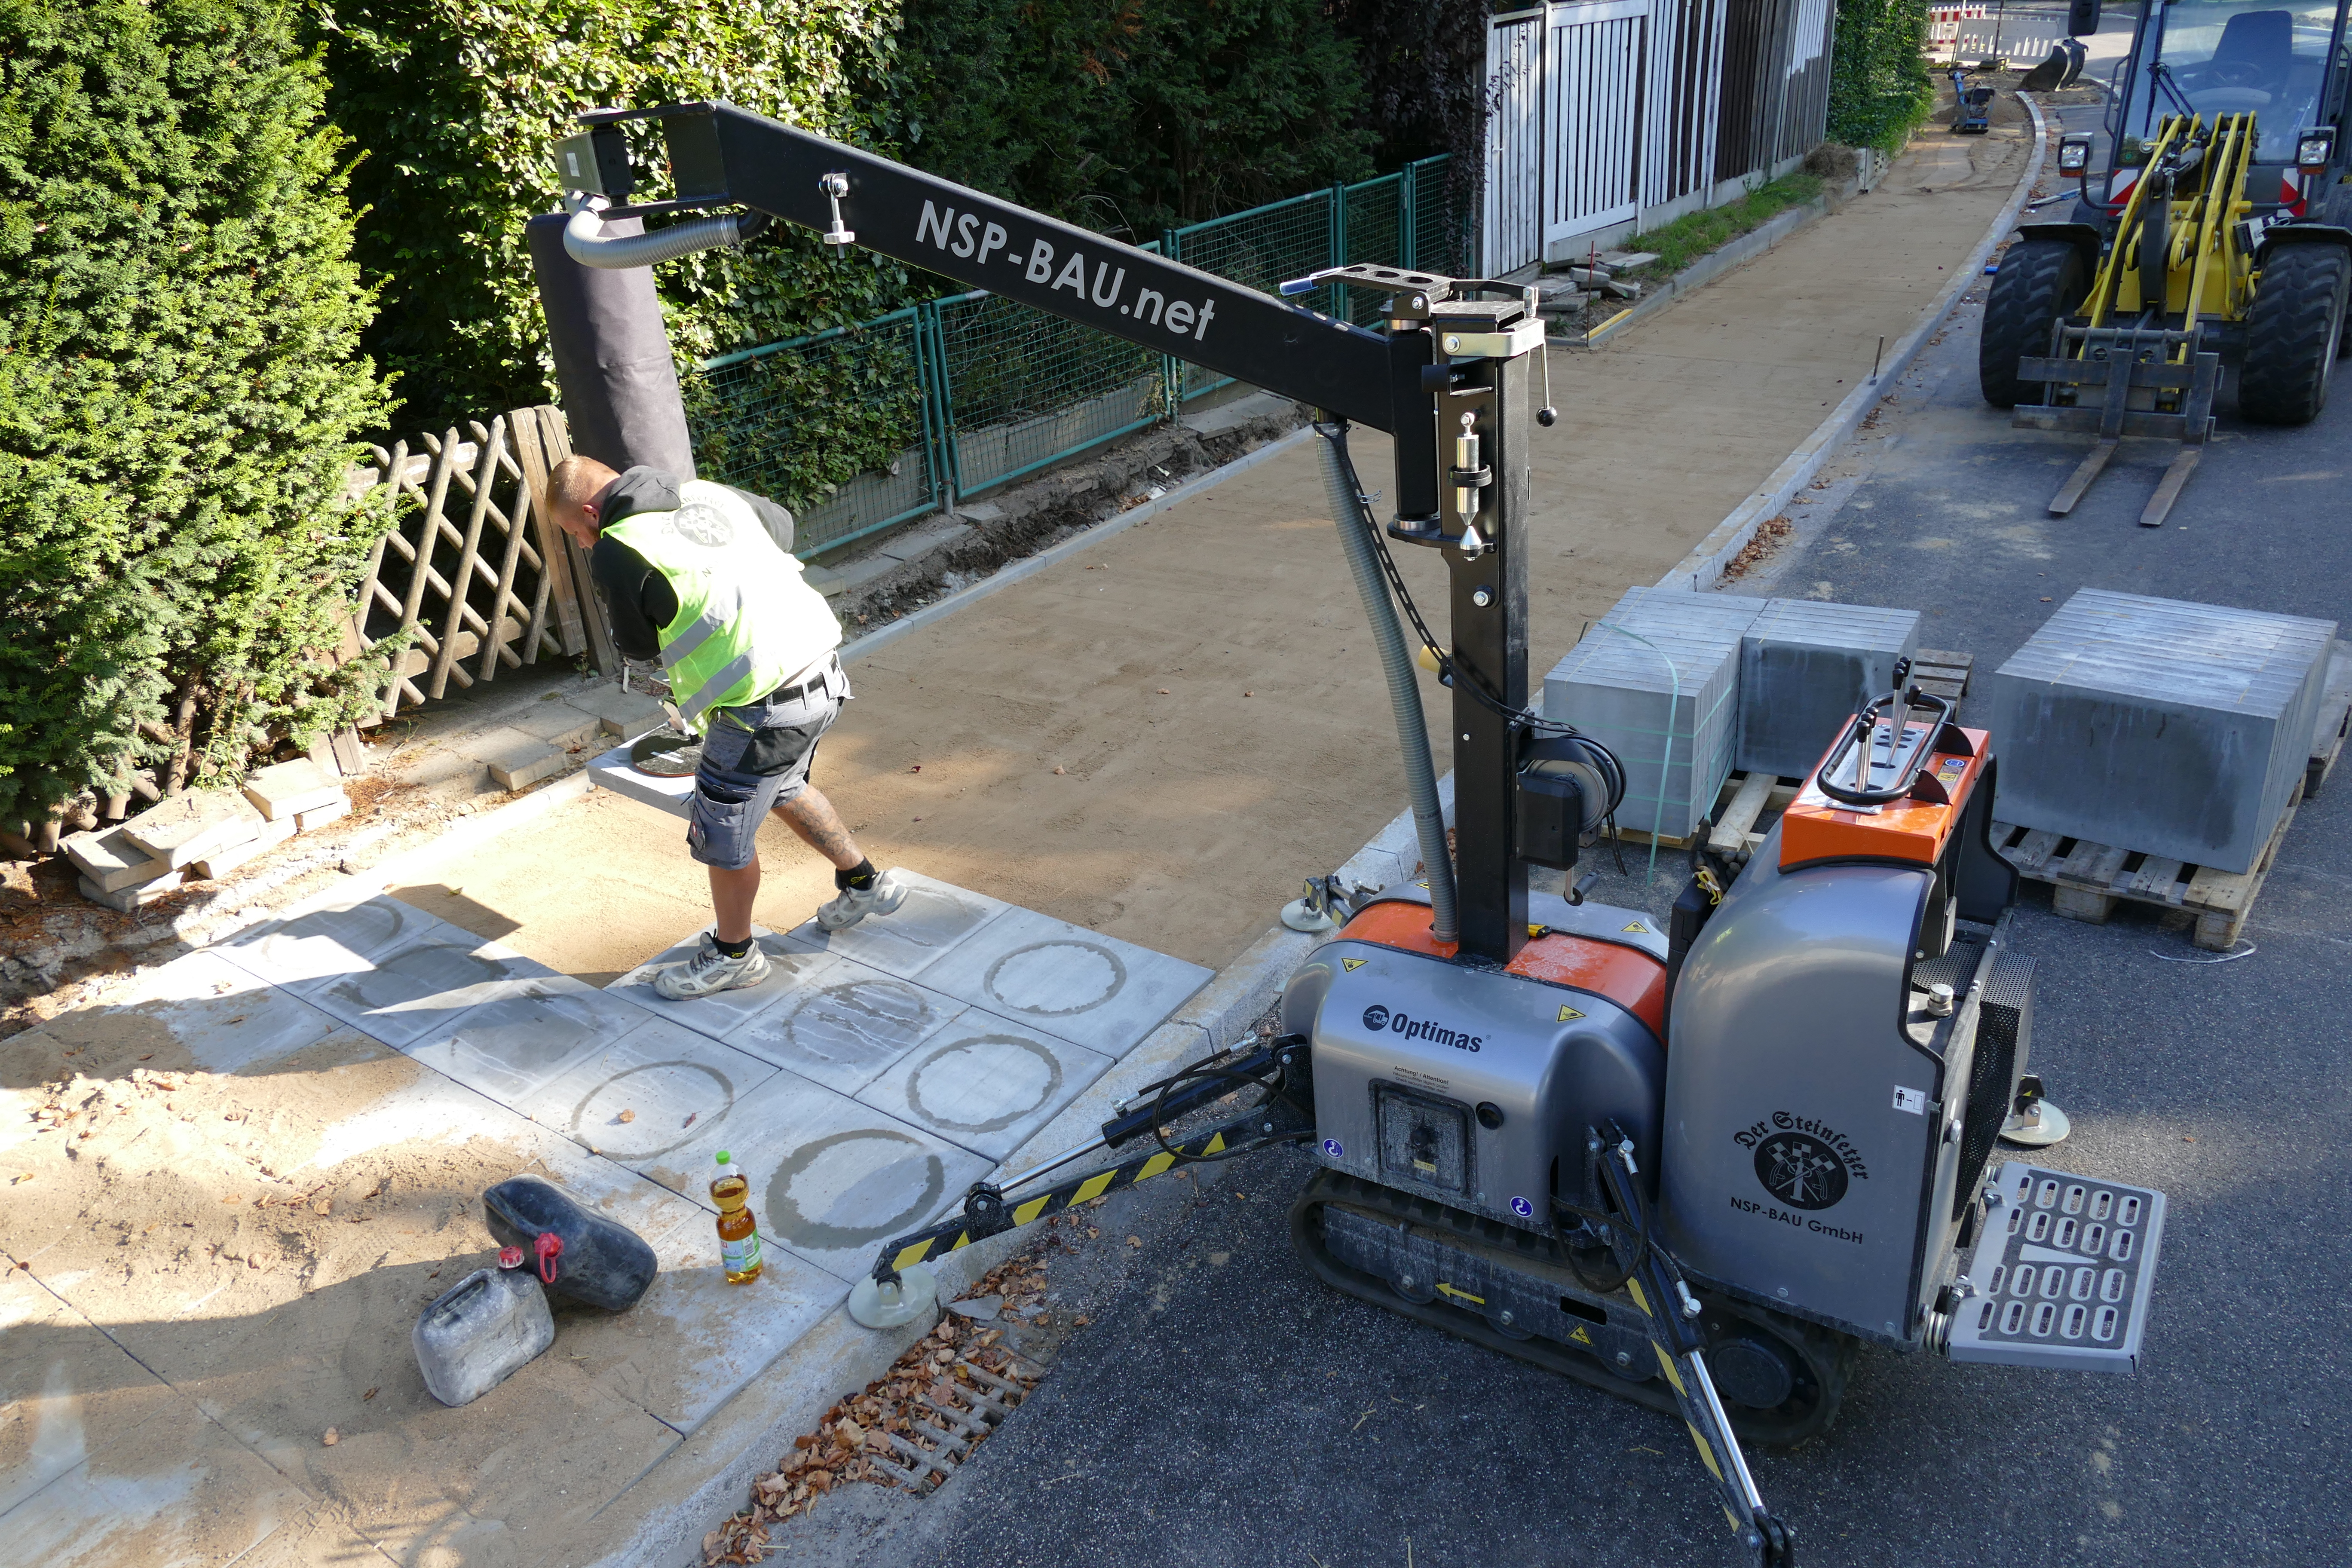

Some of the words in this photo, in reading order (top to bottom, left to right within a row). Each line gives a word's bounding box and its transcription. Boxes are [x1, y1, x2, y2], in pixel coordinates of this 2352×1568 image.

[915, 199, 1216, 341] NSP-BAU.net
[1391, 1013, 1482, 1053] Optimas
[1394, 1066, 1418, 1077] Achtung!
[1422, 1074, 1449, 1085] Attention!
[1733, 1121, 1769, 1150] Der
[1415, 1162, 1435, 1170] FILTER
[1730, 1197, 1802, 1227] NSP-BAU
[1808, 1220, 1863, 1244] GmbH
